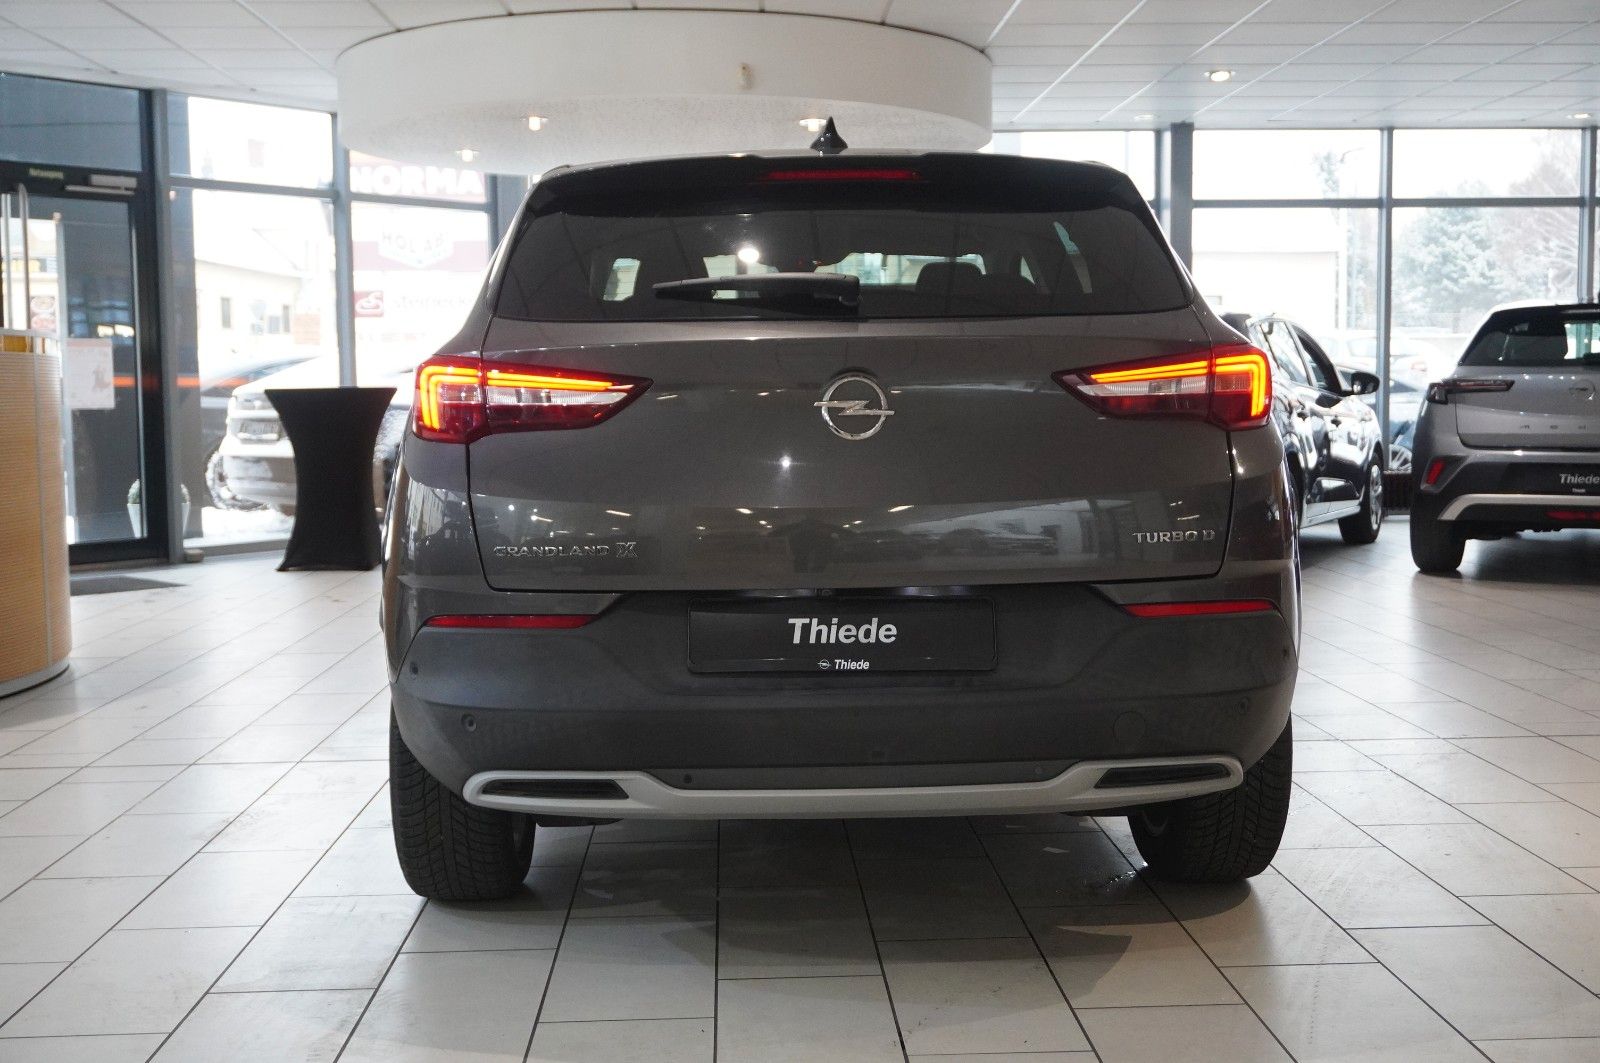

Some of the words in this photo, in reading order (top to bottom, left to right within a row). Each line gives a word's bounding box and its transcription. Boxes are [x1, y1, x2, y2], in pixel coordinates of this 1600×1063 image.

[350, 165, 485, 196] NORMA
[1560, 473, 1600, 485] Thiede
[1132, 530, 1198, 543] TURBO
[1202, 529, 1216, 541] D
[493, 545, 610, 557] GRANDLAND
[616, 541, 638, 557] X
[788, 617, 898, 644] Thiede
[834, 659, 870, 670] Thiede
